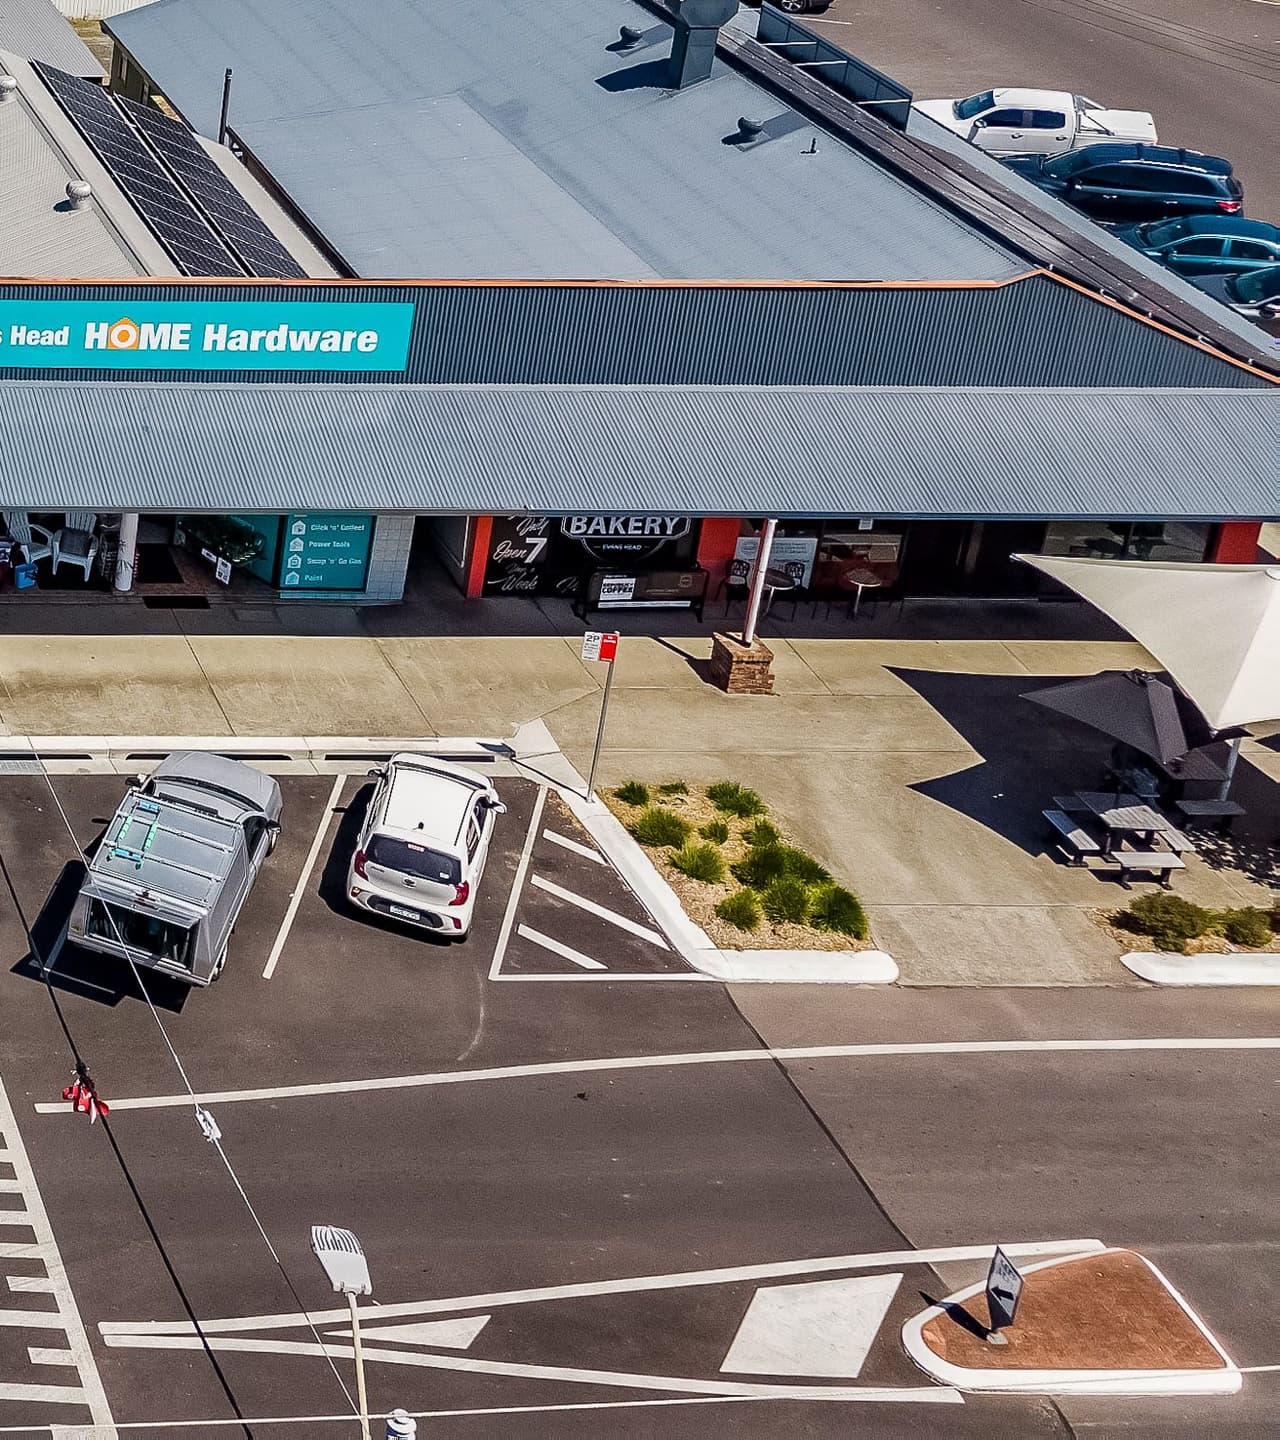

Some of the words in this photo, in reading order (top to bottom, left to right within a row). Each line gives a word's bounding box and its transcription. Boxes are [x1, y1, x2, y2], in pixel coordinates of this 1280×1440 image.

[10, 325, 70, 346] Head
[84, 320, 192, 350] HOME
[202, 323, 379, 352] Hardware
[569, 516, 681, 535] BAKERY
[493, 540, 527, 563] Open
[524, 537, 547, 563] 7
[586, 634, 600, 643] 2P
